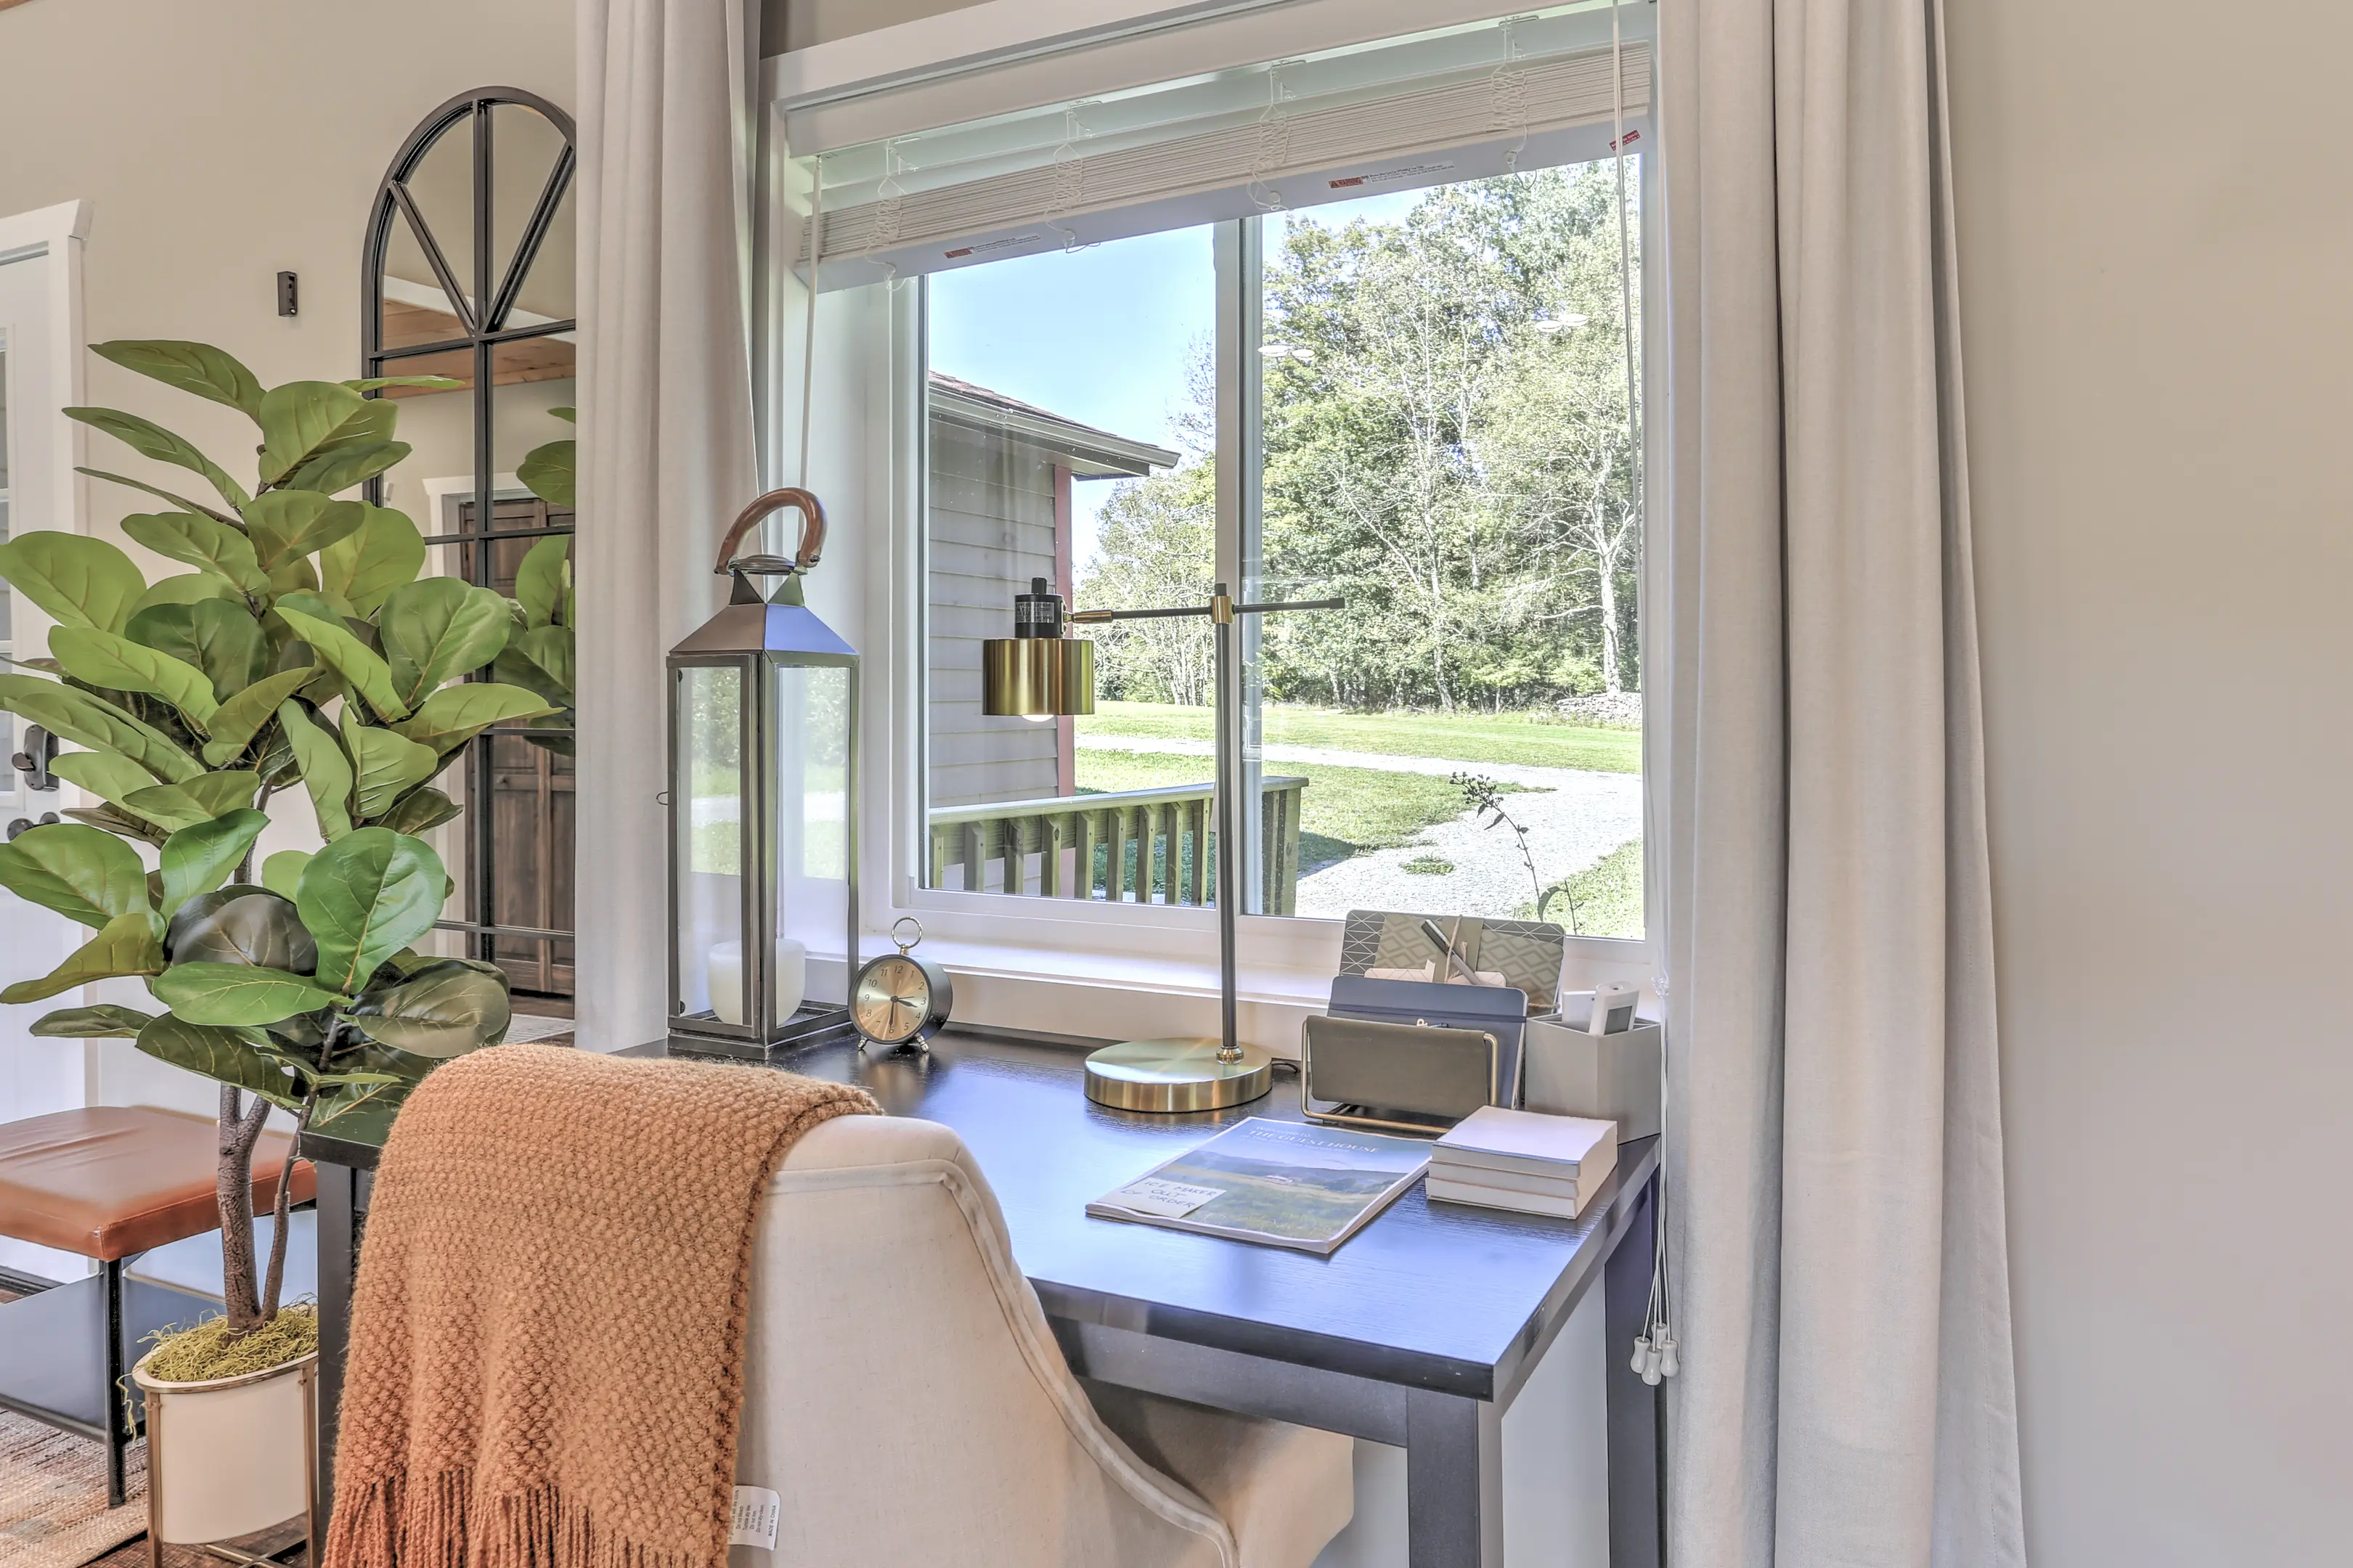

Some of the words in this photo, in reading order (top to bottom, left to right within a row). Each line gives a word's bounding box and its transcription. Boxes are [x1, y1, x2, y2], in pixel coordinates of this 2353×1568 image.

[1338, 176, 1362, 187] WARNING
[921, 997, 926, 1005] 3
[1279, 1135, 1326, 1146] GUEST
[1327, 1142, 1380, 1153] HOUSE
[1151, 1189, 1186, 1198] OUT
[1173, 1186, 1218, 1196] MAKER
[1149, 1195, 1196, 1208] ORDER
